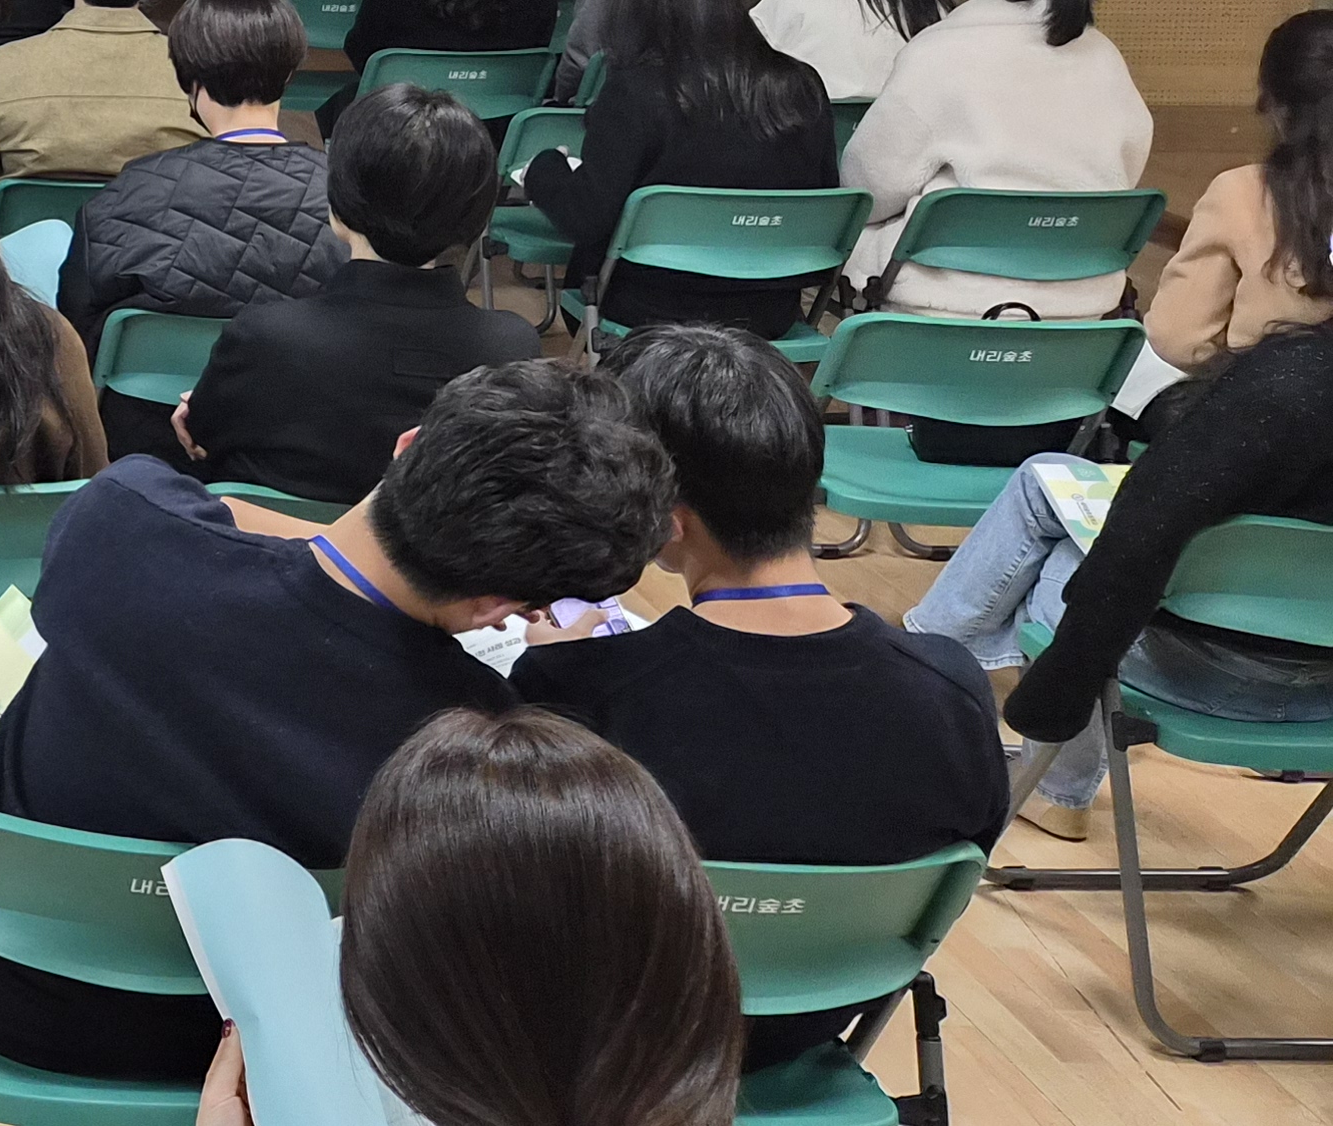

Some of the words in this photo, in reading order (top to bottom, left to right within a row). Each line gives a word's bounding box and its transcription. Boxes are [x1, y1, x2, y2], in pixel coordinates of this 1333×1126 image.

[448, 71, 486, 79] 내리숲초
[732, 216, 782, 225] 내리숲초
[1028, 217, 1079, 226] 내리숲초
[970, 350, 1032, 362] 내리숲초
[131, 878, 168, 898] 내리
